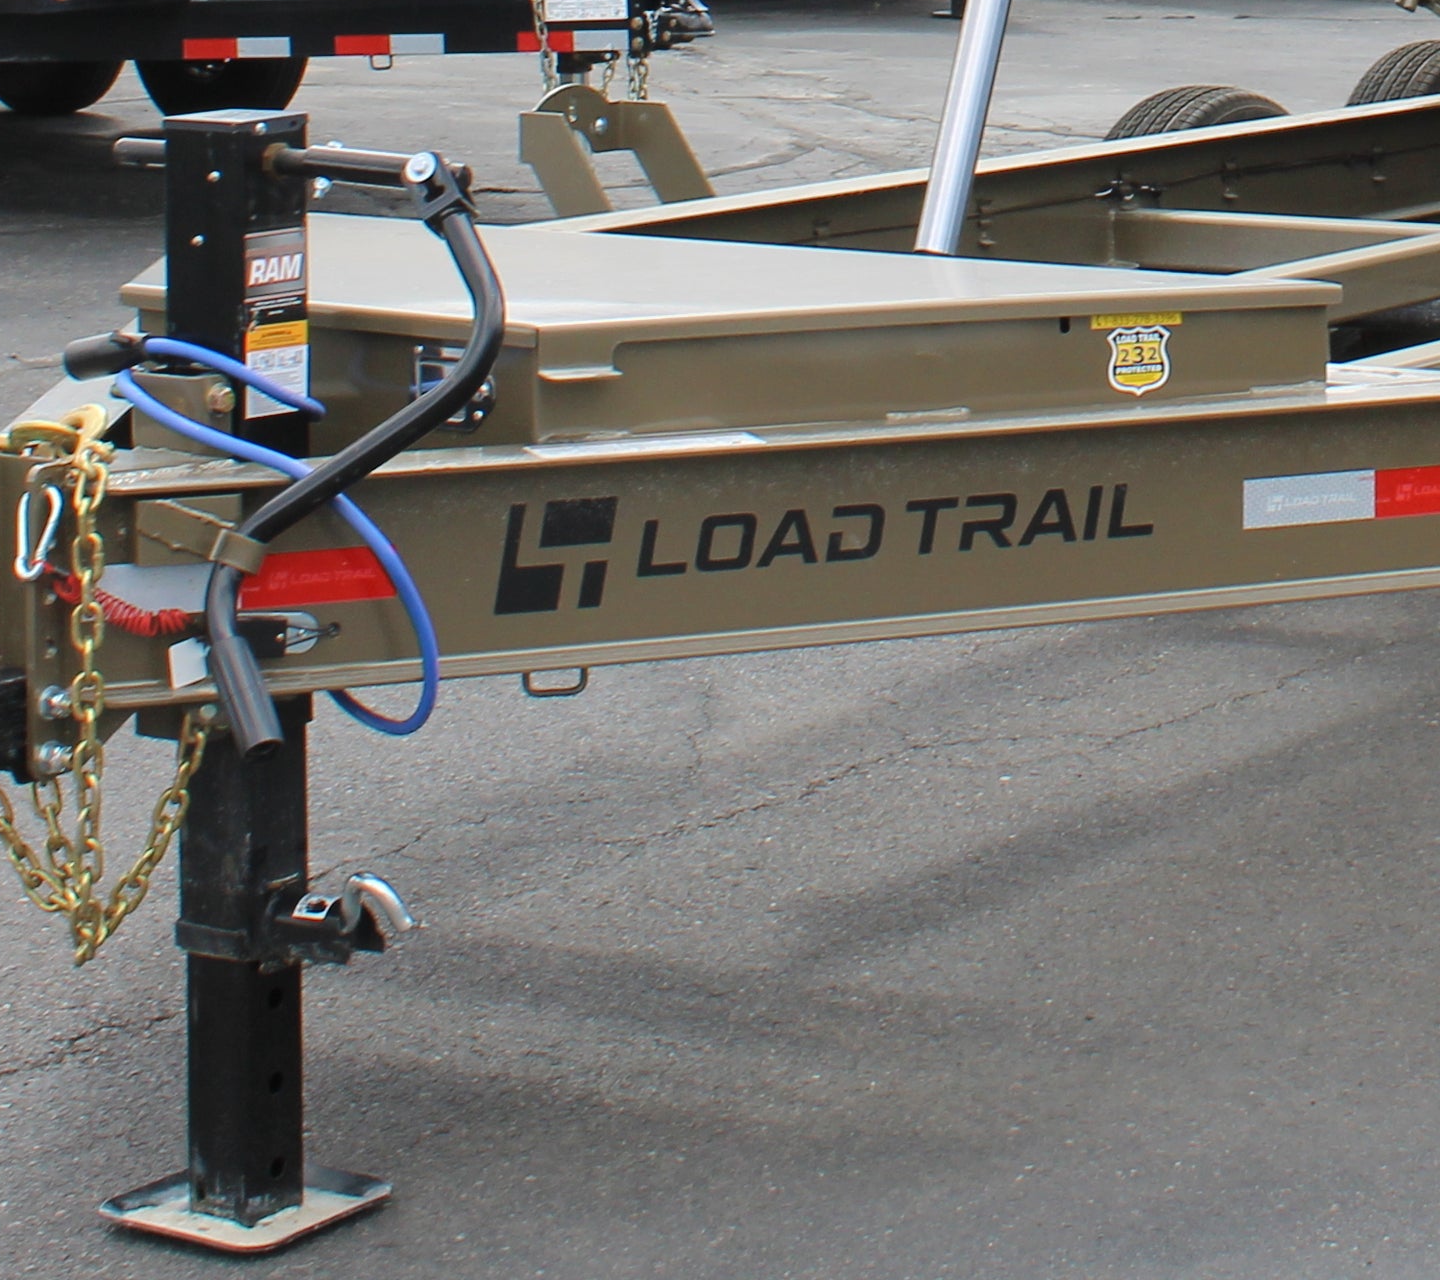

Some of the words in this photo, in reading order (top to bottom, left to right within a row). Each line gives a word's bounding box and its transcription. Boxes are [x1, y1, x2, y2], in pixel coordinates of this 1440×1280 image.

[247, 252, 304, 288] RAM
[636, 503, 886, 578] LOAD
[905, 483, 1155, 555] TRAIL
